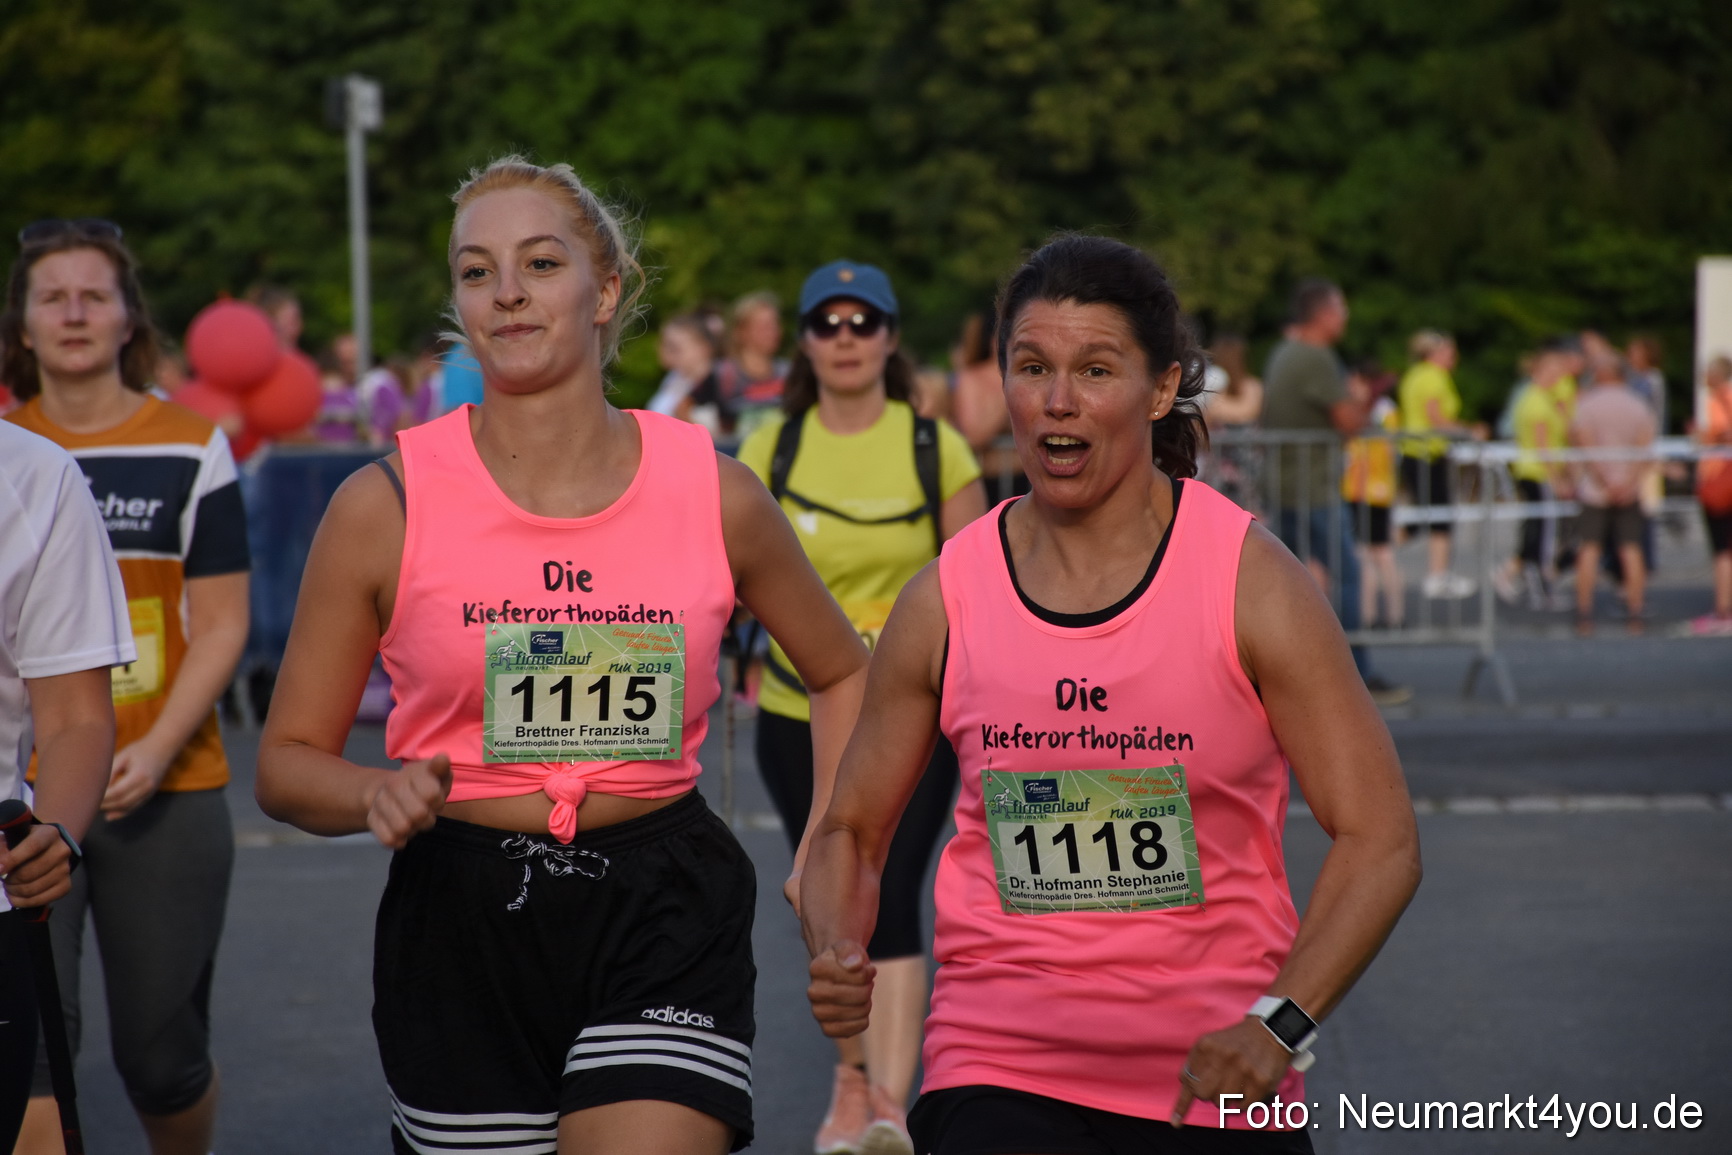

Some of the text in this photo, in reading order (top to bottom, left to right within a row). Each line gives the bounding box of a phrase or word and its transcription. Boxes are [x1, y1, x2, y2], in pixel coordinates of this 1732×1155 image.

[543, 560, 594, 593] Die
[463, 599, 674, 627] Kieferorthopäden
[516, 651, 593, 665] firmenlauf
[636, 662, 672, 674] 2019
[511, 675, 657, 723] 1115
[1055, 677, 1109, 712] Die
[515, 724, 650, 738] Brettner Franziska
[494, 737, 669, 748] Kieferorthopädie Dres. Hofmann und Schmidt
[981, 723, 1194, 760] Kieferorthopäden
[1107, 773, 1142, 784] Gesunde
[1013, 797, 1091, 814] firmenlauf
[1139, 804, 1176, 818] 2019
[1014, 821, 1168, 875] 1118
[1009, 870, 1185, 891] Dr. Hofmann Stephanie
[1009, 882, 1189, 901] Kieferorthopädie Dres. Hofmann und Schmidt
[641, 1005, 715, 1029] adidas
